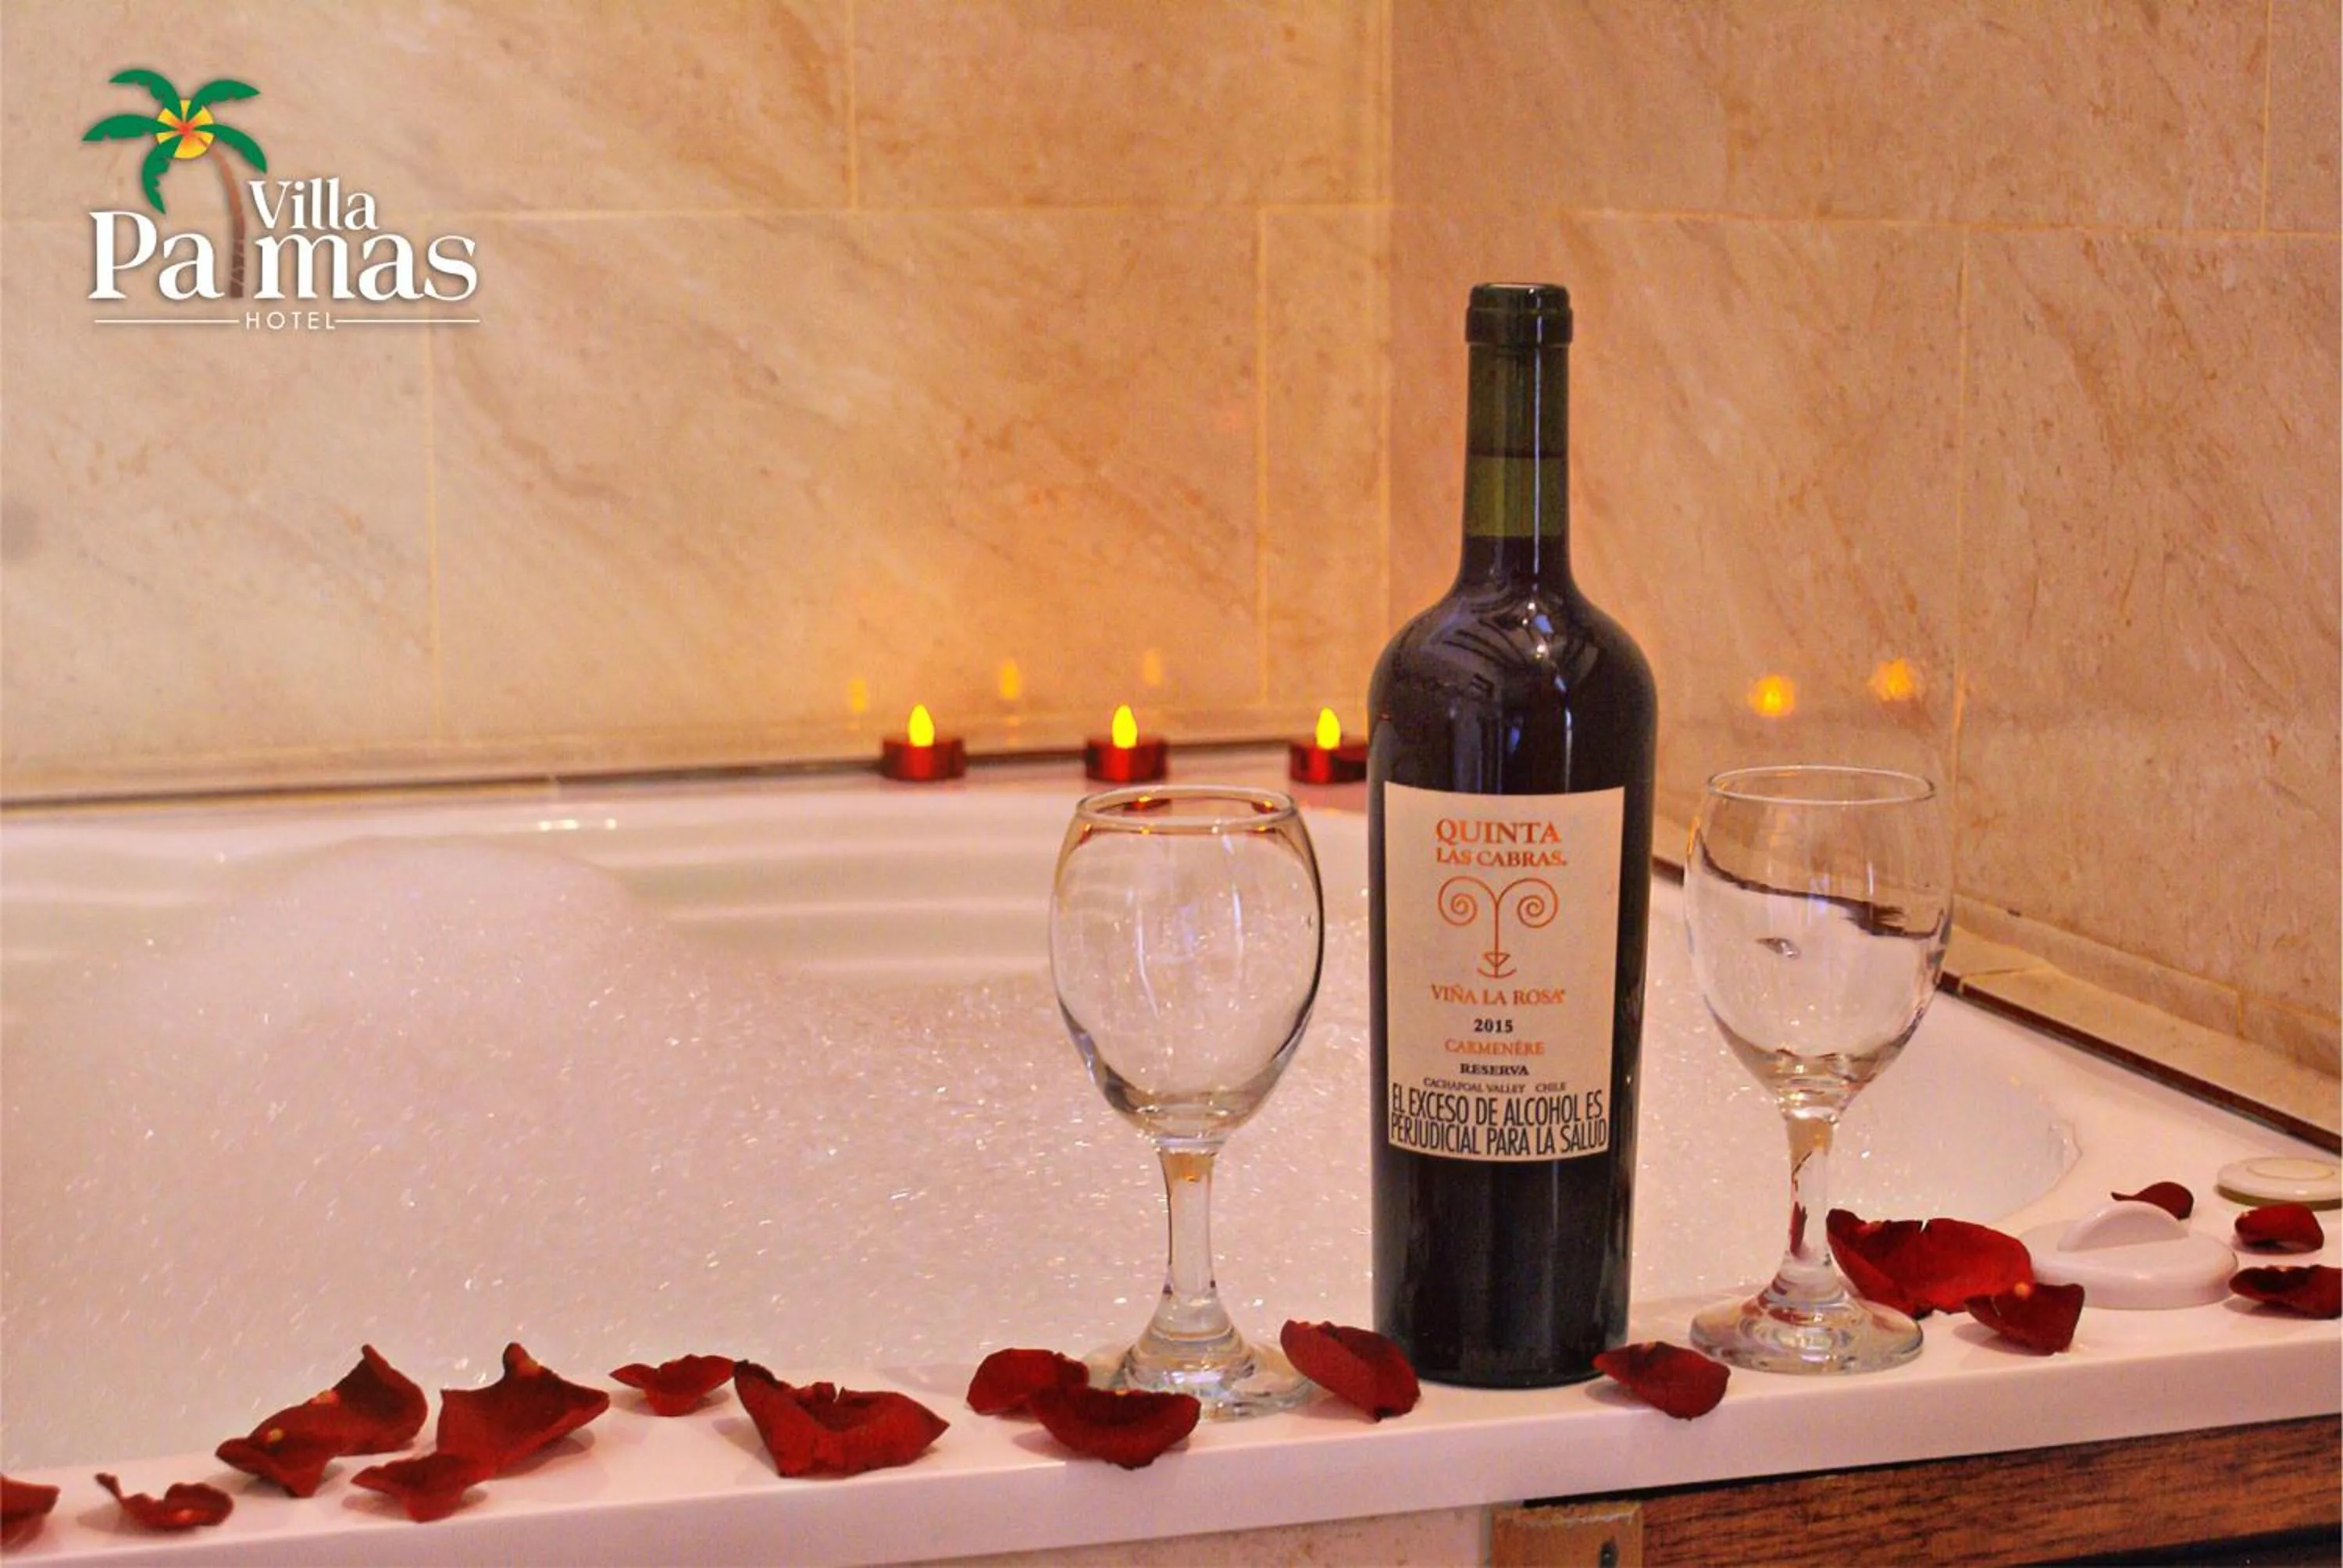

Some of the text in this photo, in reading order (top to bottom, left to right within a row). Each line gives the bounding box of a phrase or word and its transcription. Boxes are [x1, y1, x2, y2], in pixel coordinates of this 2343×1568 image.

[1436, 818, 1561, 845] QUINTA
[1436, 847, 1471, 865] LAS
[1431, 984, 1478, 1005] VIÑA
[1482, 989, 1507, 1006] LA
[1474, 1018, 1514, 1034] 2015
[1460, 1063, 1530, 1076] RESERVA
[1486, 1084, 1526, 1094] VALLEY
[1535, 1082, 1566, 1093] CHILE
[1393, 1082, 1603, 1127] EL EXCESO DE ALCOHOL ES
[1390, 1111, 1607, 1156] PERJUDICIAL PARA LA SALUD
